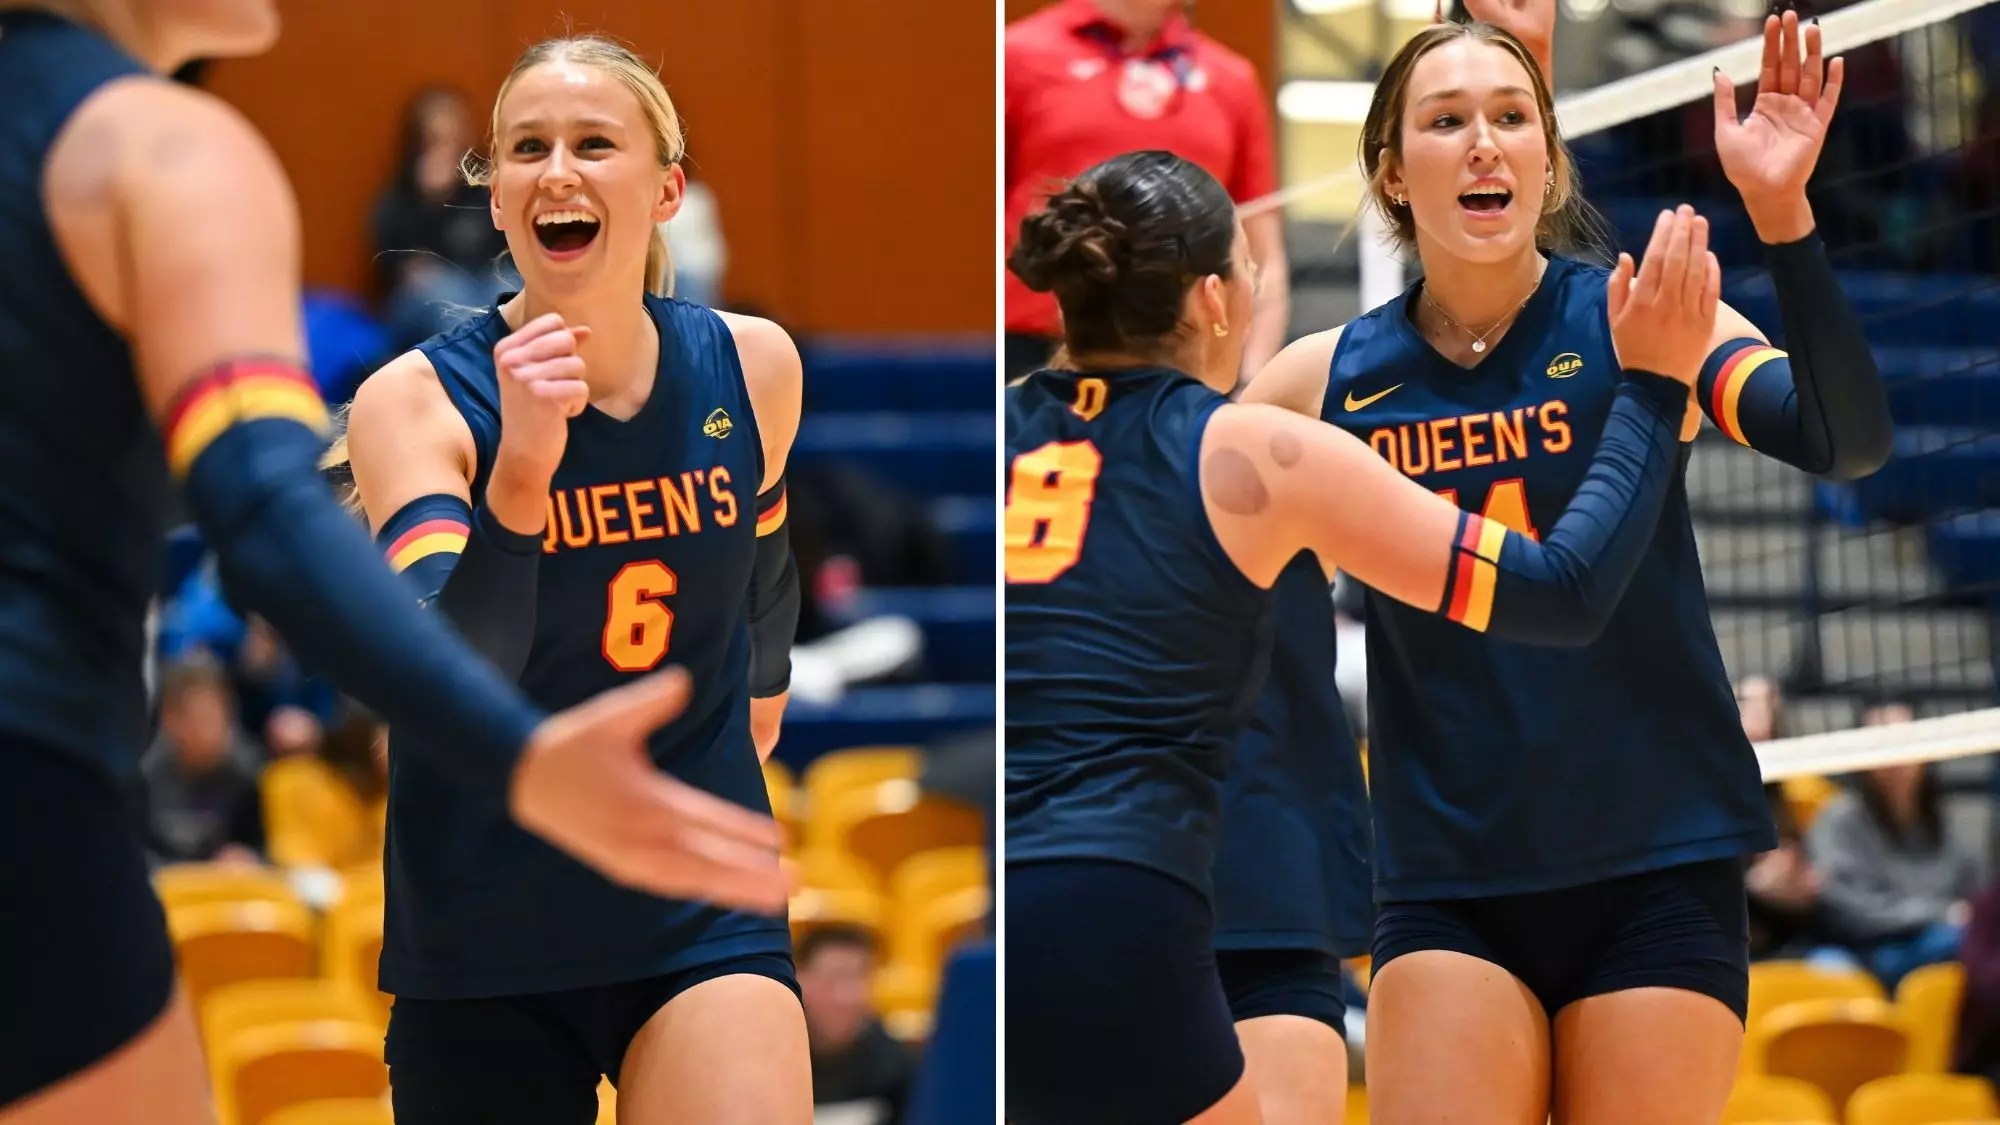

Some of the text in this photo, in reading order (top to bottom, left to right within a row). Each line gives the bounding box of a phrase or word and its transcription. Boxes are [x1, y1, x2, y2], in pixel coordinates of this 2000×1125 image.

[1546, 359, 1584, 378] OUA
[1370, 399, 1573, 476] QUEEN'S
[1005, 438, 1103, 584] 8
[602, 558, 678, 672] 6
